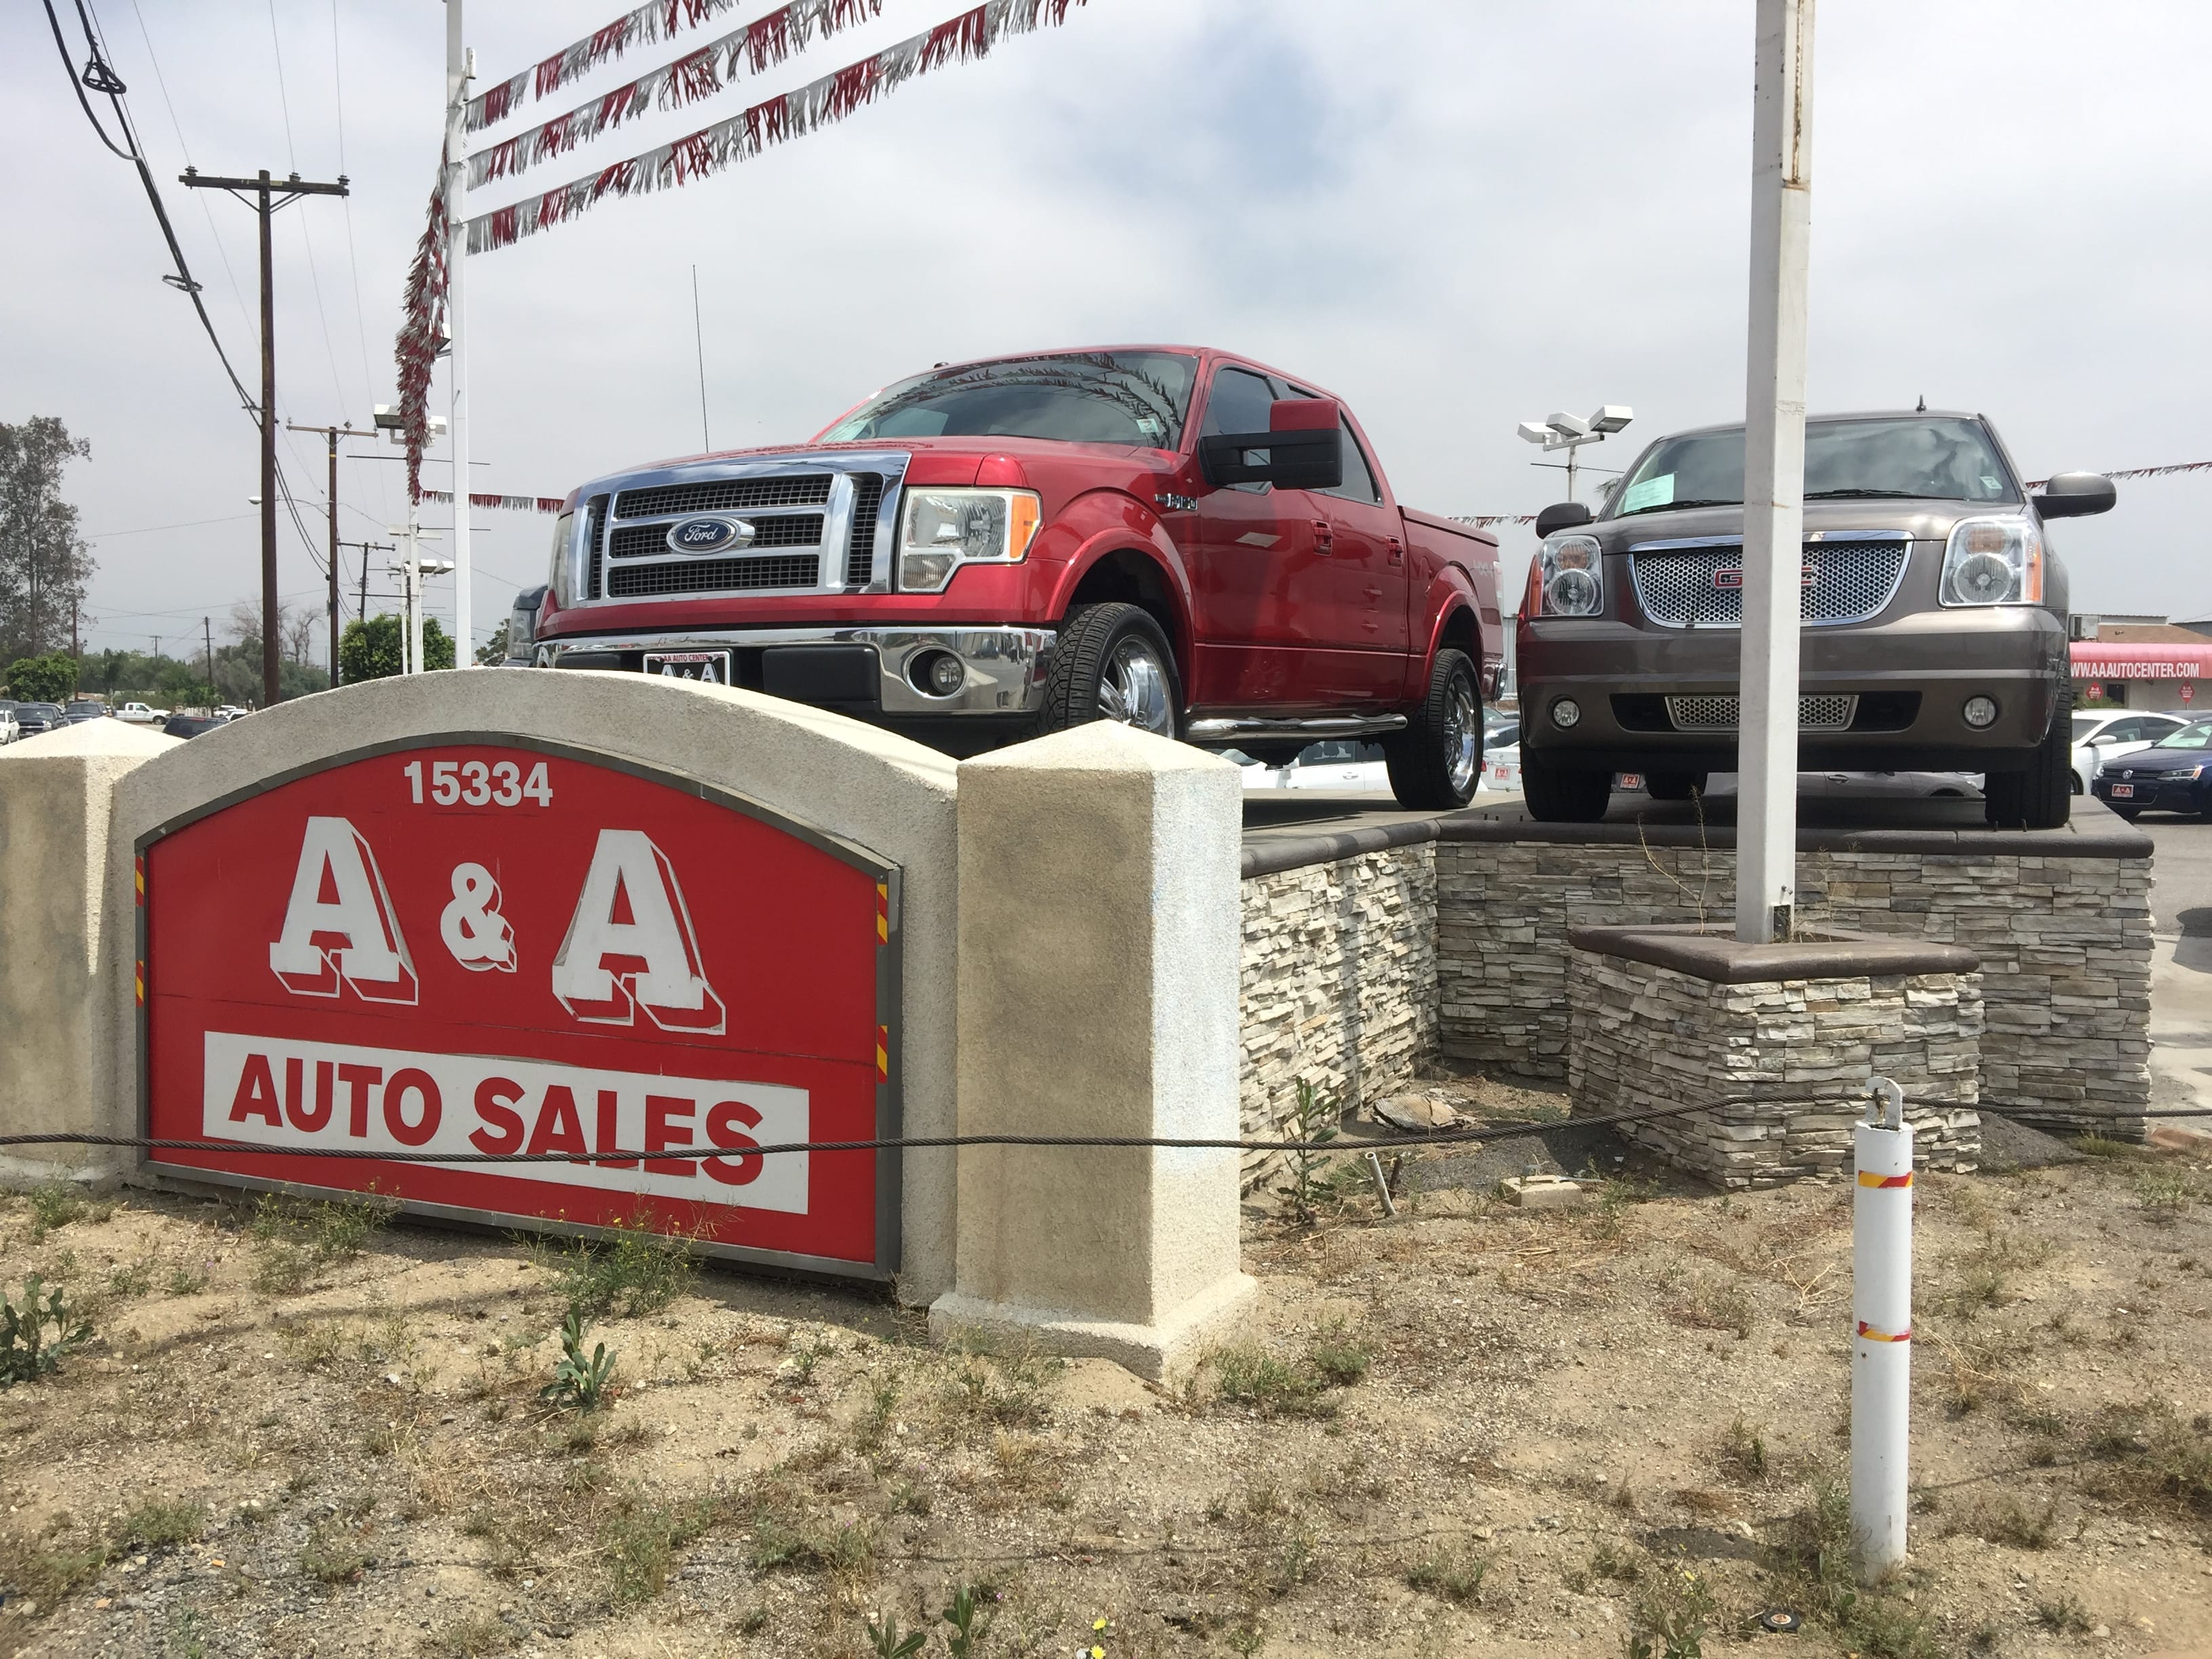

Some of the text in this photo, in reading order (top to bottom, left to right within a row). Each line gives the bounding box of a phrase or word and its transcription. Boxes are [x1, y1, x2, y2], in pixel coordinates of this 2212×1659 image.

[684, 525, 718, 541] Ford
[673, 654, 687, 662] AUTO
[689, 653, 709, 661] CENTER
[403, 760, 554, 807] 15334
[270, 815, 726, 1036] A & A
[228, 1053, 764, 1186] AUTO SALES
